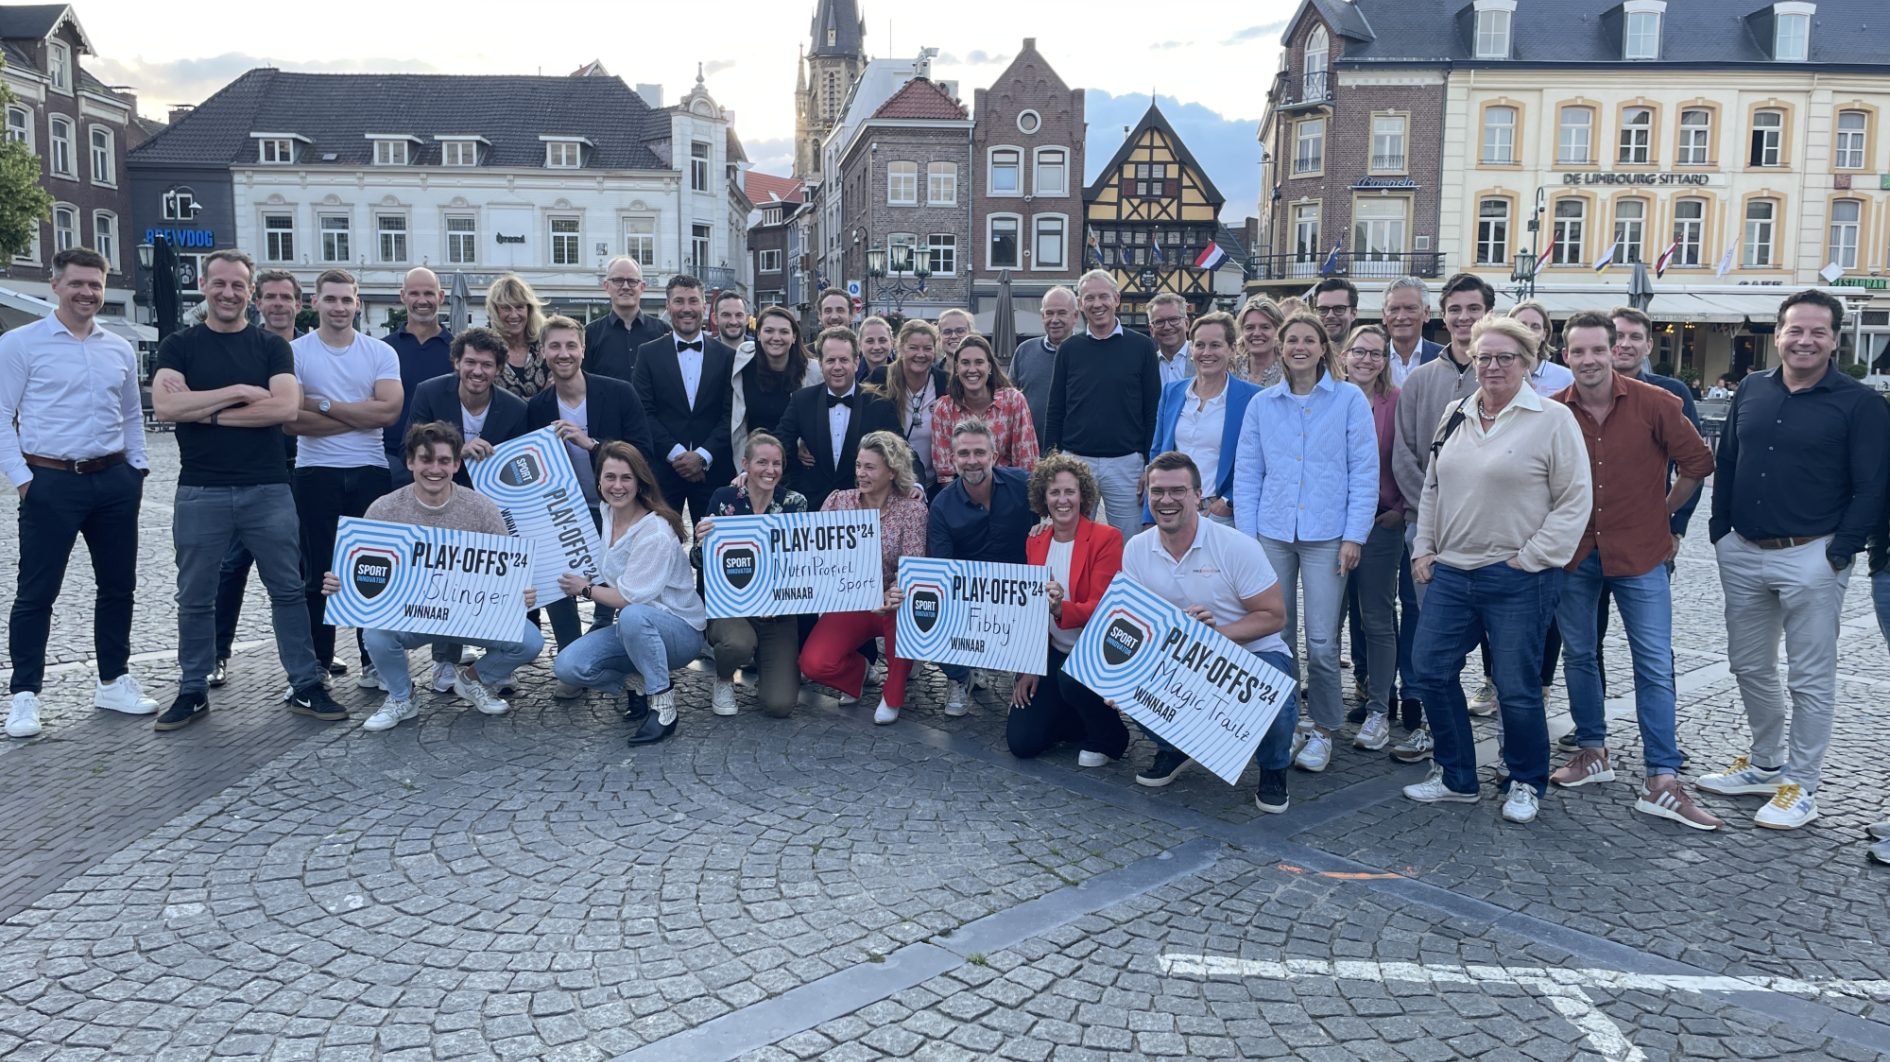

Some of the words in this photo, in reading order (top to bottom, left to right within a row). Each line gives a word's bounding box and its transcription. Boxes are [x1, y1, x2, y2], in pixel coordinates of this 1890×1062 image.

[1563, 173, 1582, 185] DE
[1585, 173, 1657, 185] LIMBOURG
[1659, 173, 1710, 186] SITTARD
[515, 457, 534, 482] SPORT
[357, 563, 388, 578] SPORT
[726, 557, 752, 568] SPORT
[773, 587, 814, 600] WINNAAR
[838, 577, 877, 594] Sport
[423, 573, 510, 617] Slinger
[404, 604, 450, 621] WINNAAR
[915, 599, 937, 611] SPORT
[951, 637, 985, 653] WINNAAR
[1110, 625, 1139, 650] SPORT
[1150, 660, 1206, 711] Magic
[1133, 685, 1177, 723] WINNAAR
